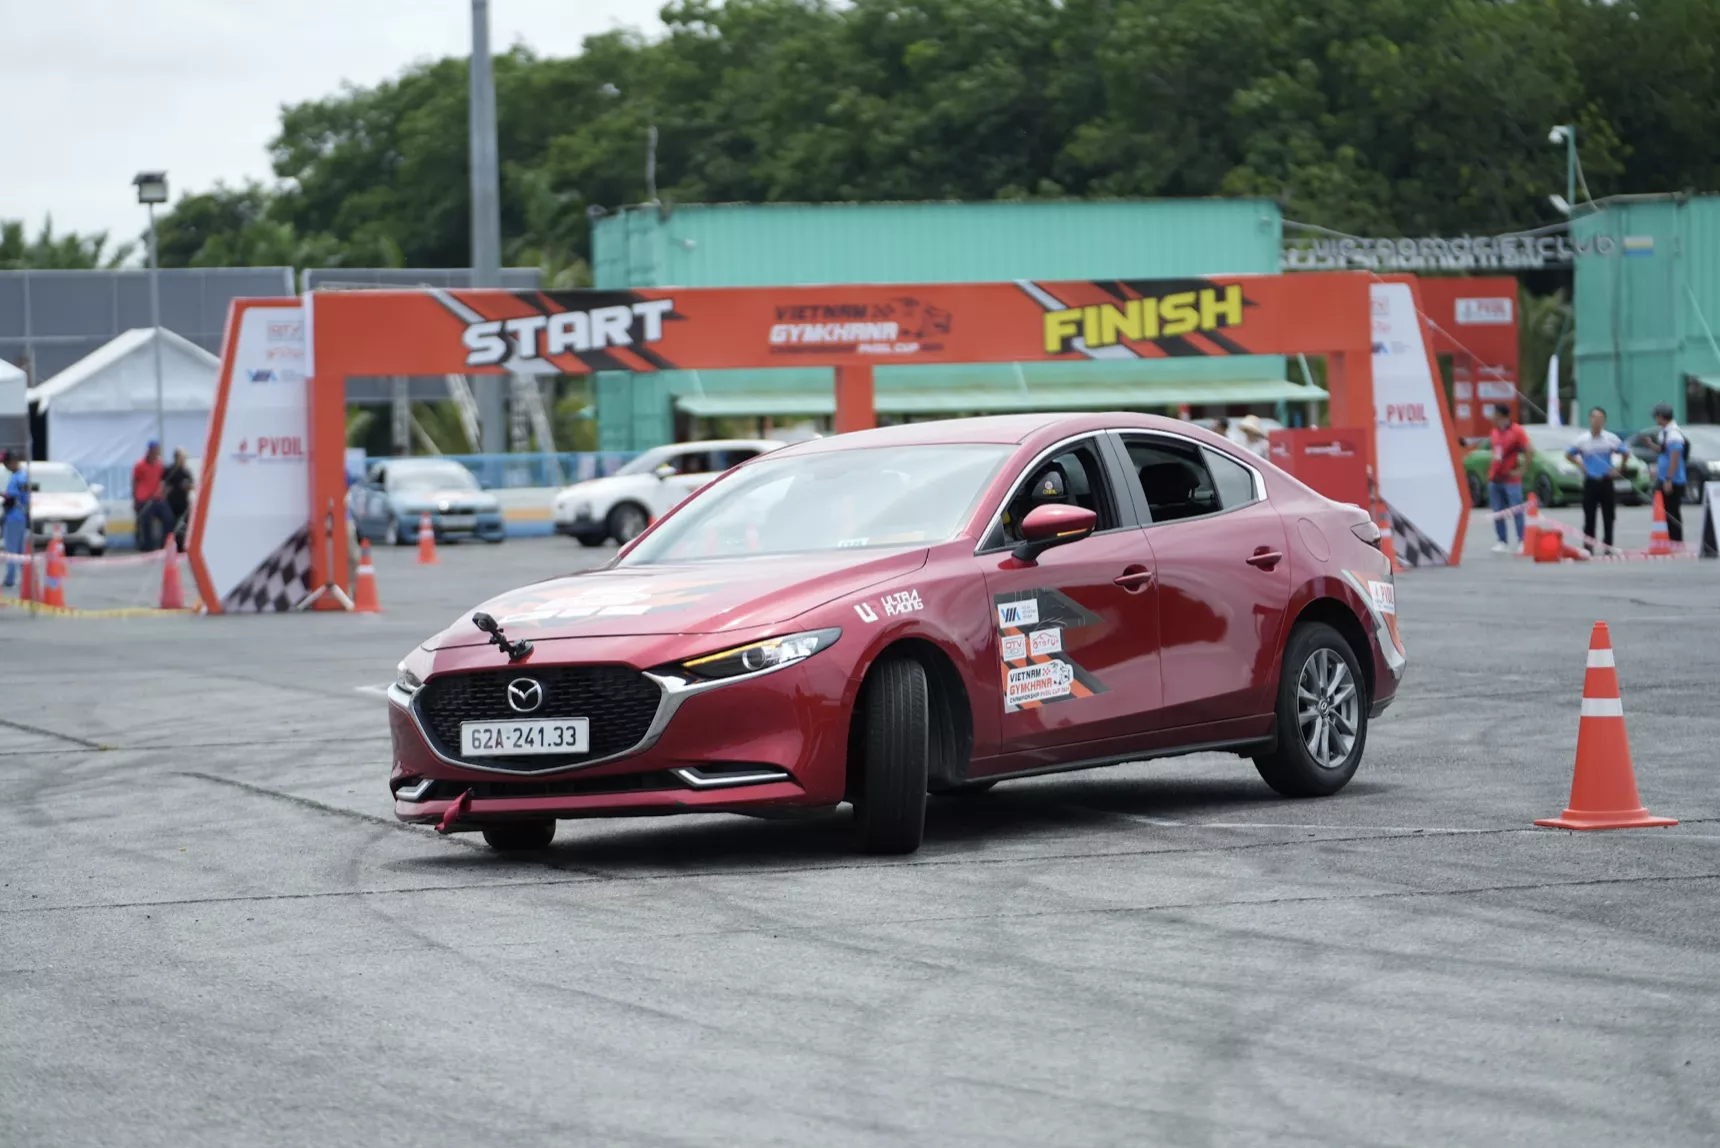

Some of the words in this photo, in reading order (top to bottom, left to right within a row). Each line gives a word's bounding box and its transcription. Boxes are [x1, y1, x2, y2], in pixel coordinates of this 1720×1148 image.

[775, 304, 867, 319] VIETNAM
[1043, 284, 1242, 353] FINISH
[462, 299, 673, 367] START
[769, 321, 899, 344] GYMKHANA
[257, 436, 304, 456] PVOIL
[881, 589, 922, 607] ULTRA
[884, 599, 924, 617] RACING
[1010, 668, 1042, 683] VIETNAM
[1010, 677, 1053, 697] GYMKHANA
[471, 725, 577, 750] 62A-241.33
